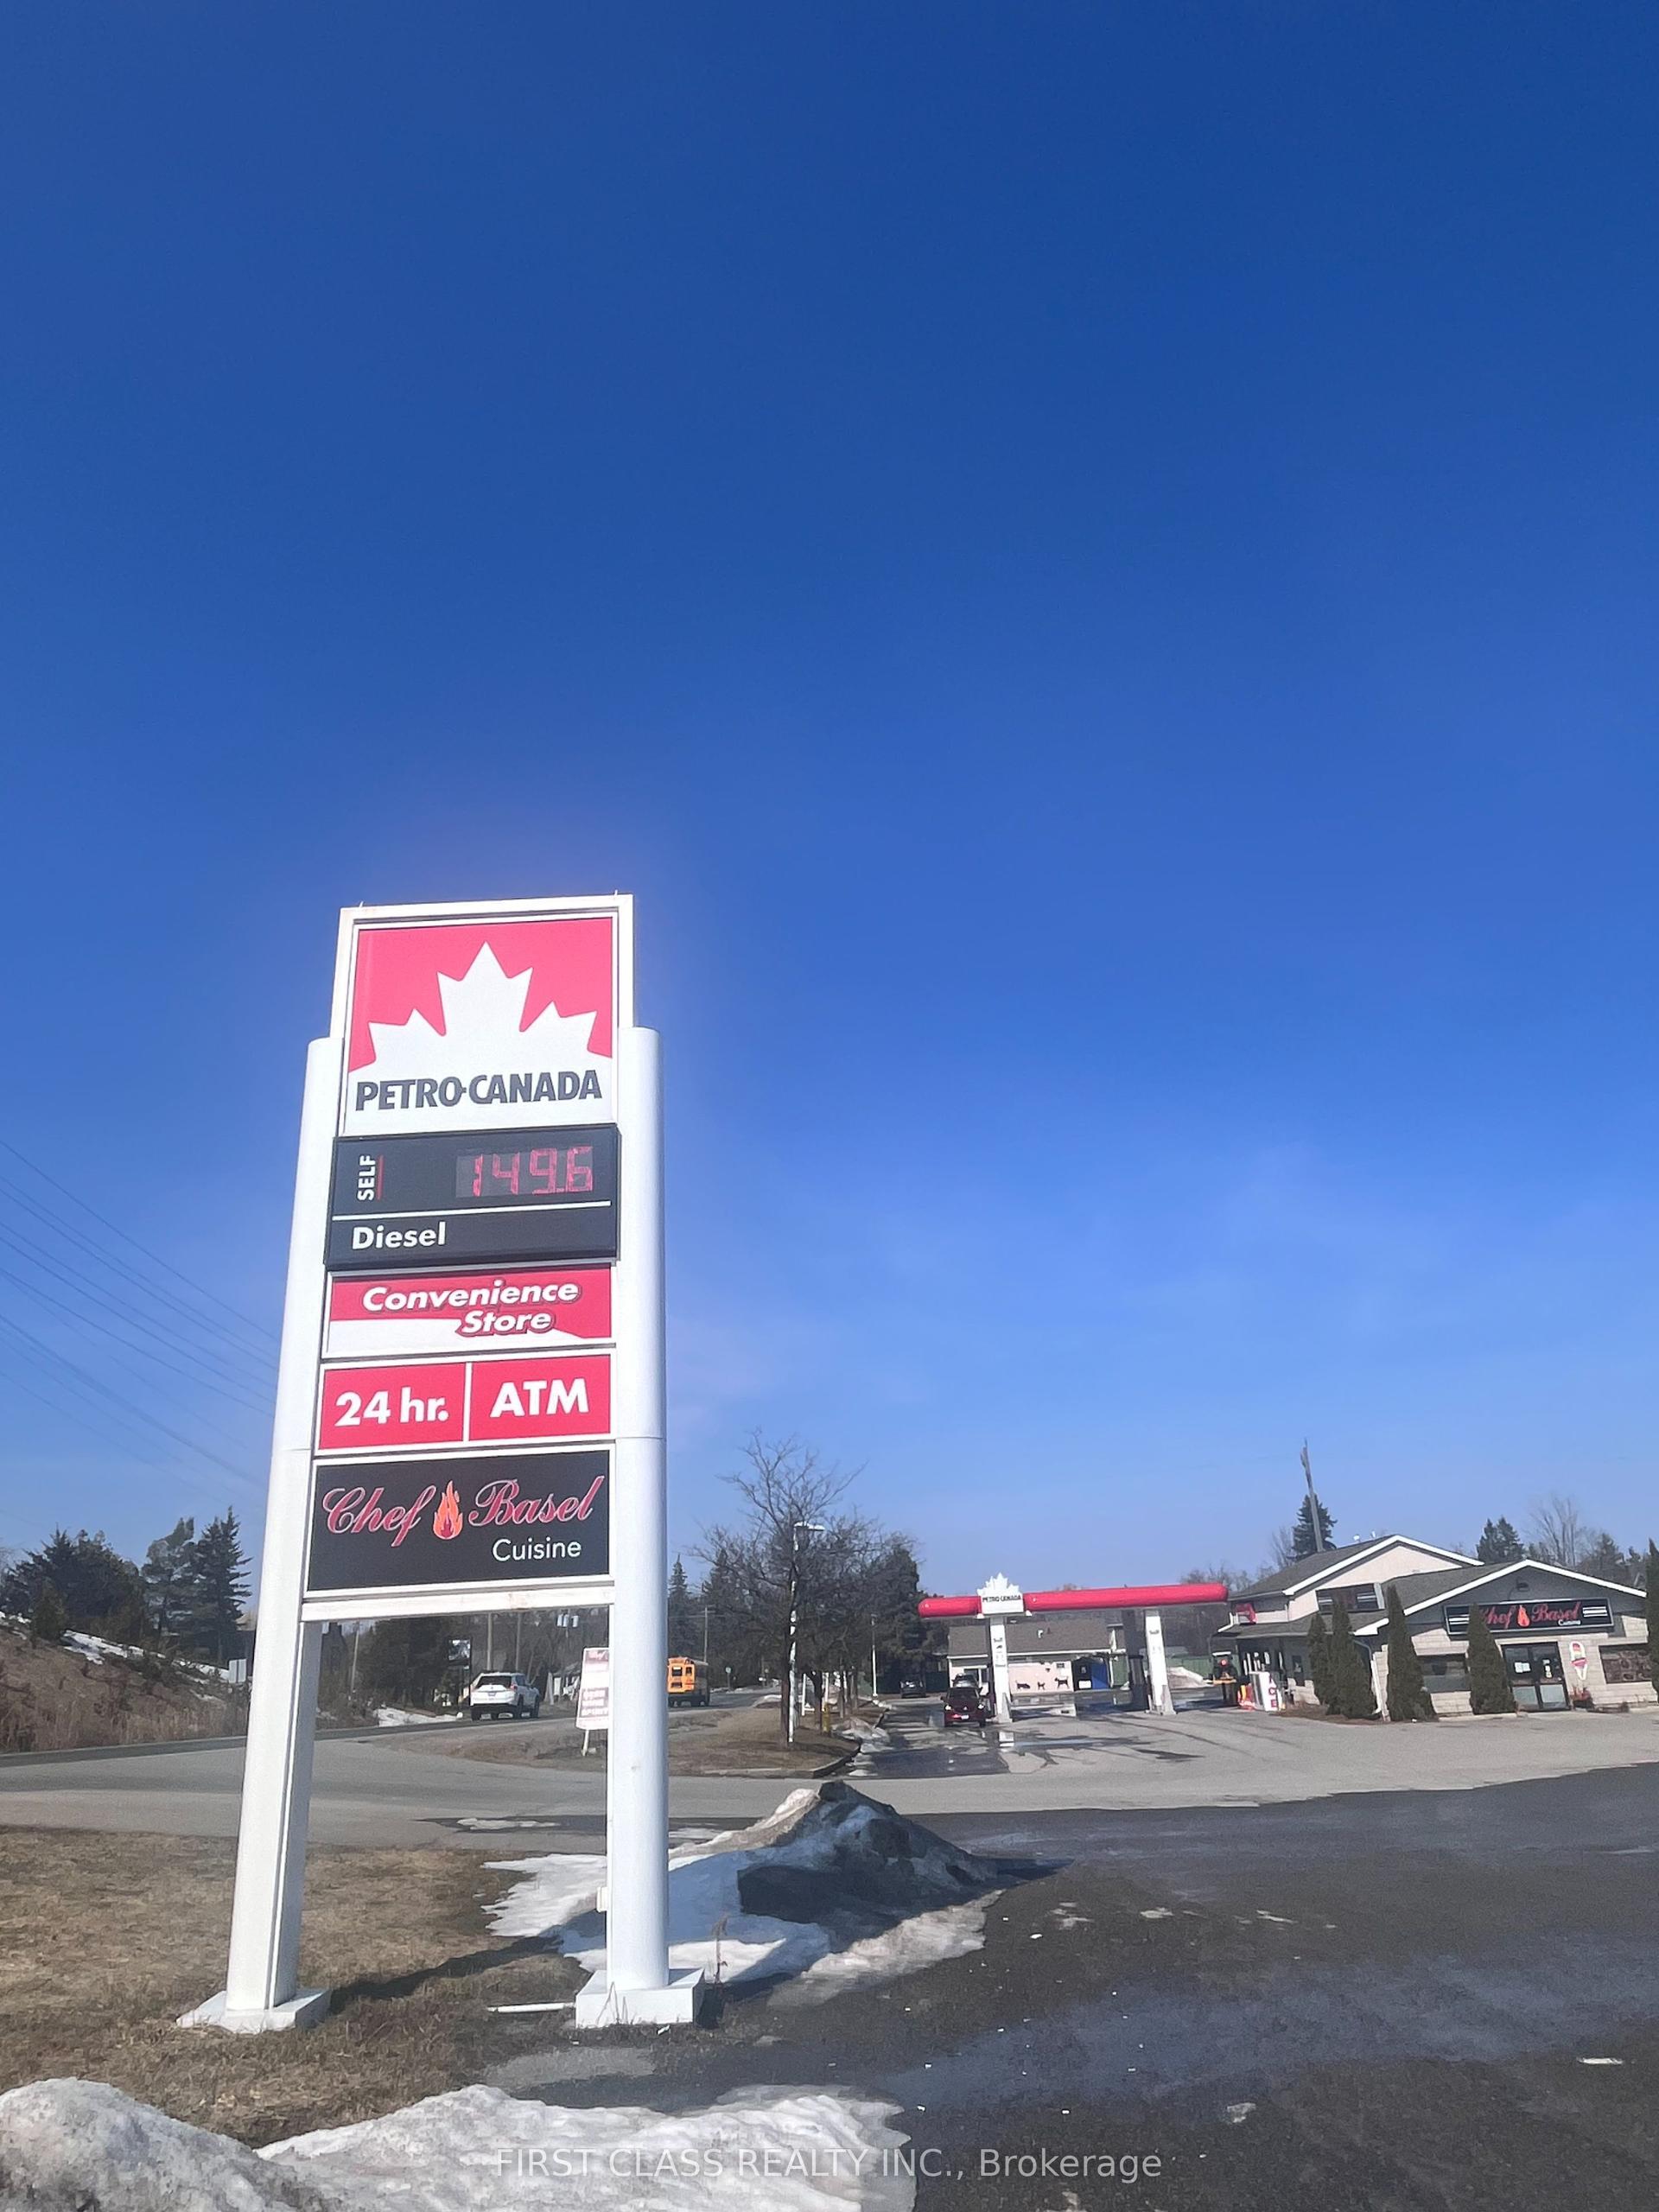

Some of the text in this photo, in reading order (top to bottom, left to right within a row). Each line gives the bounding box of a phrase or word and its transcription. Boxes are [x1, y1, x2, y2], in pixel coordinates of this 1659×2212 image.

[358, 1155, 375, 1201] SELF
[352, 1222, 447, 1249] Diesel
[362, 1280, 581, 1312] Convenience
[460, 1310, 553, 1333] Store
[334, 1387, 449, 1427] 24 hr.
[489, 1378, 589, 1418] ATM
[322, 1475, 605, 1548] Chef Basel
[492, 1537, 582, 1561] Cuisine
